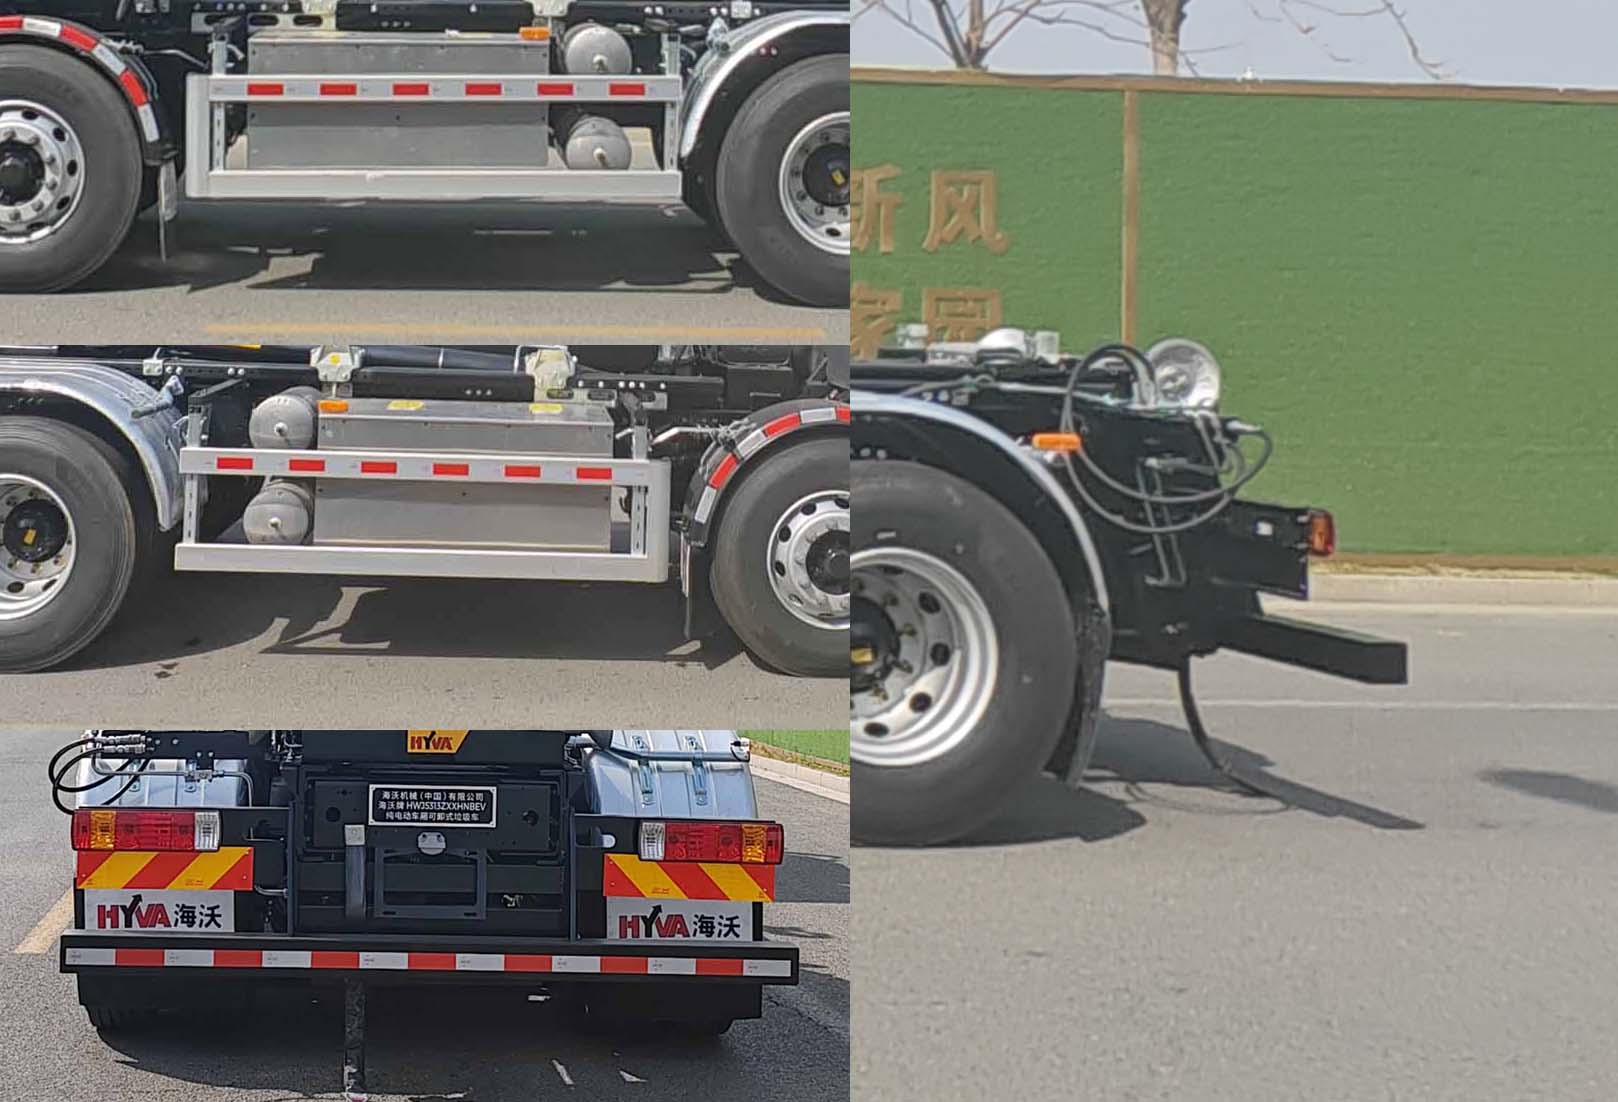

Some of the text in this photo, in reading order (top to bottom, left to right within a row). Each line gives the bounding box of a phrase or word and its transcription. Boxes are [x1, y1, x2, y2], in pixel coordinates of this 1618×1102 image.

[410, 731, 453, 750] HYVA
[97, 894, 222, 929] HYVA 海沃
[618, 905, 741, 939] HYVA 海沃
